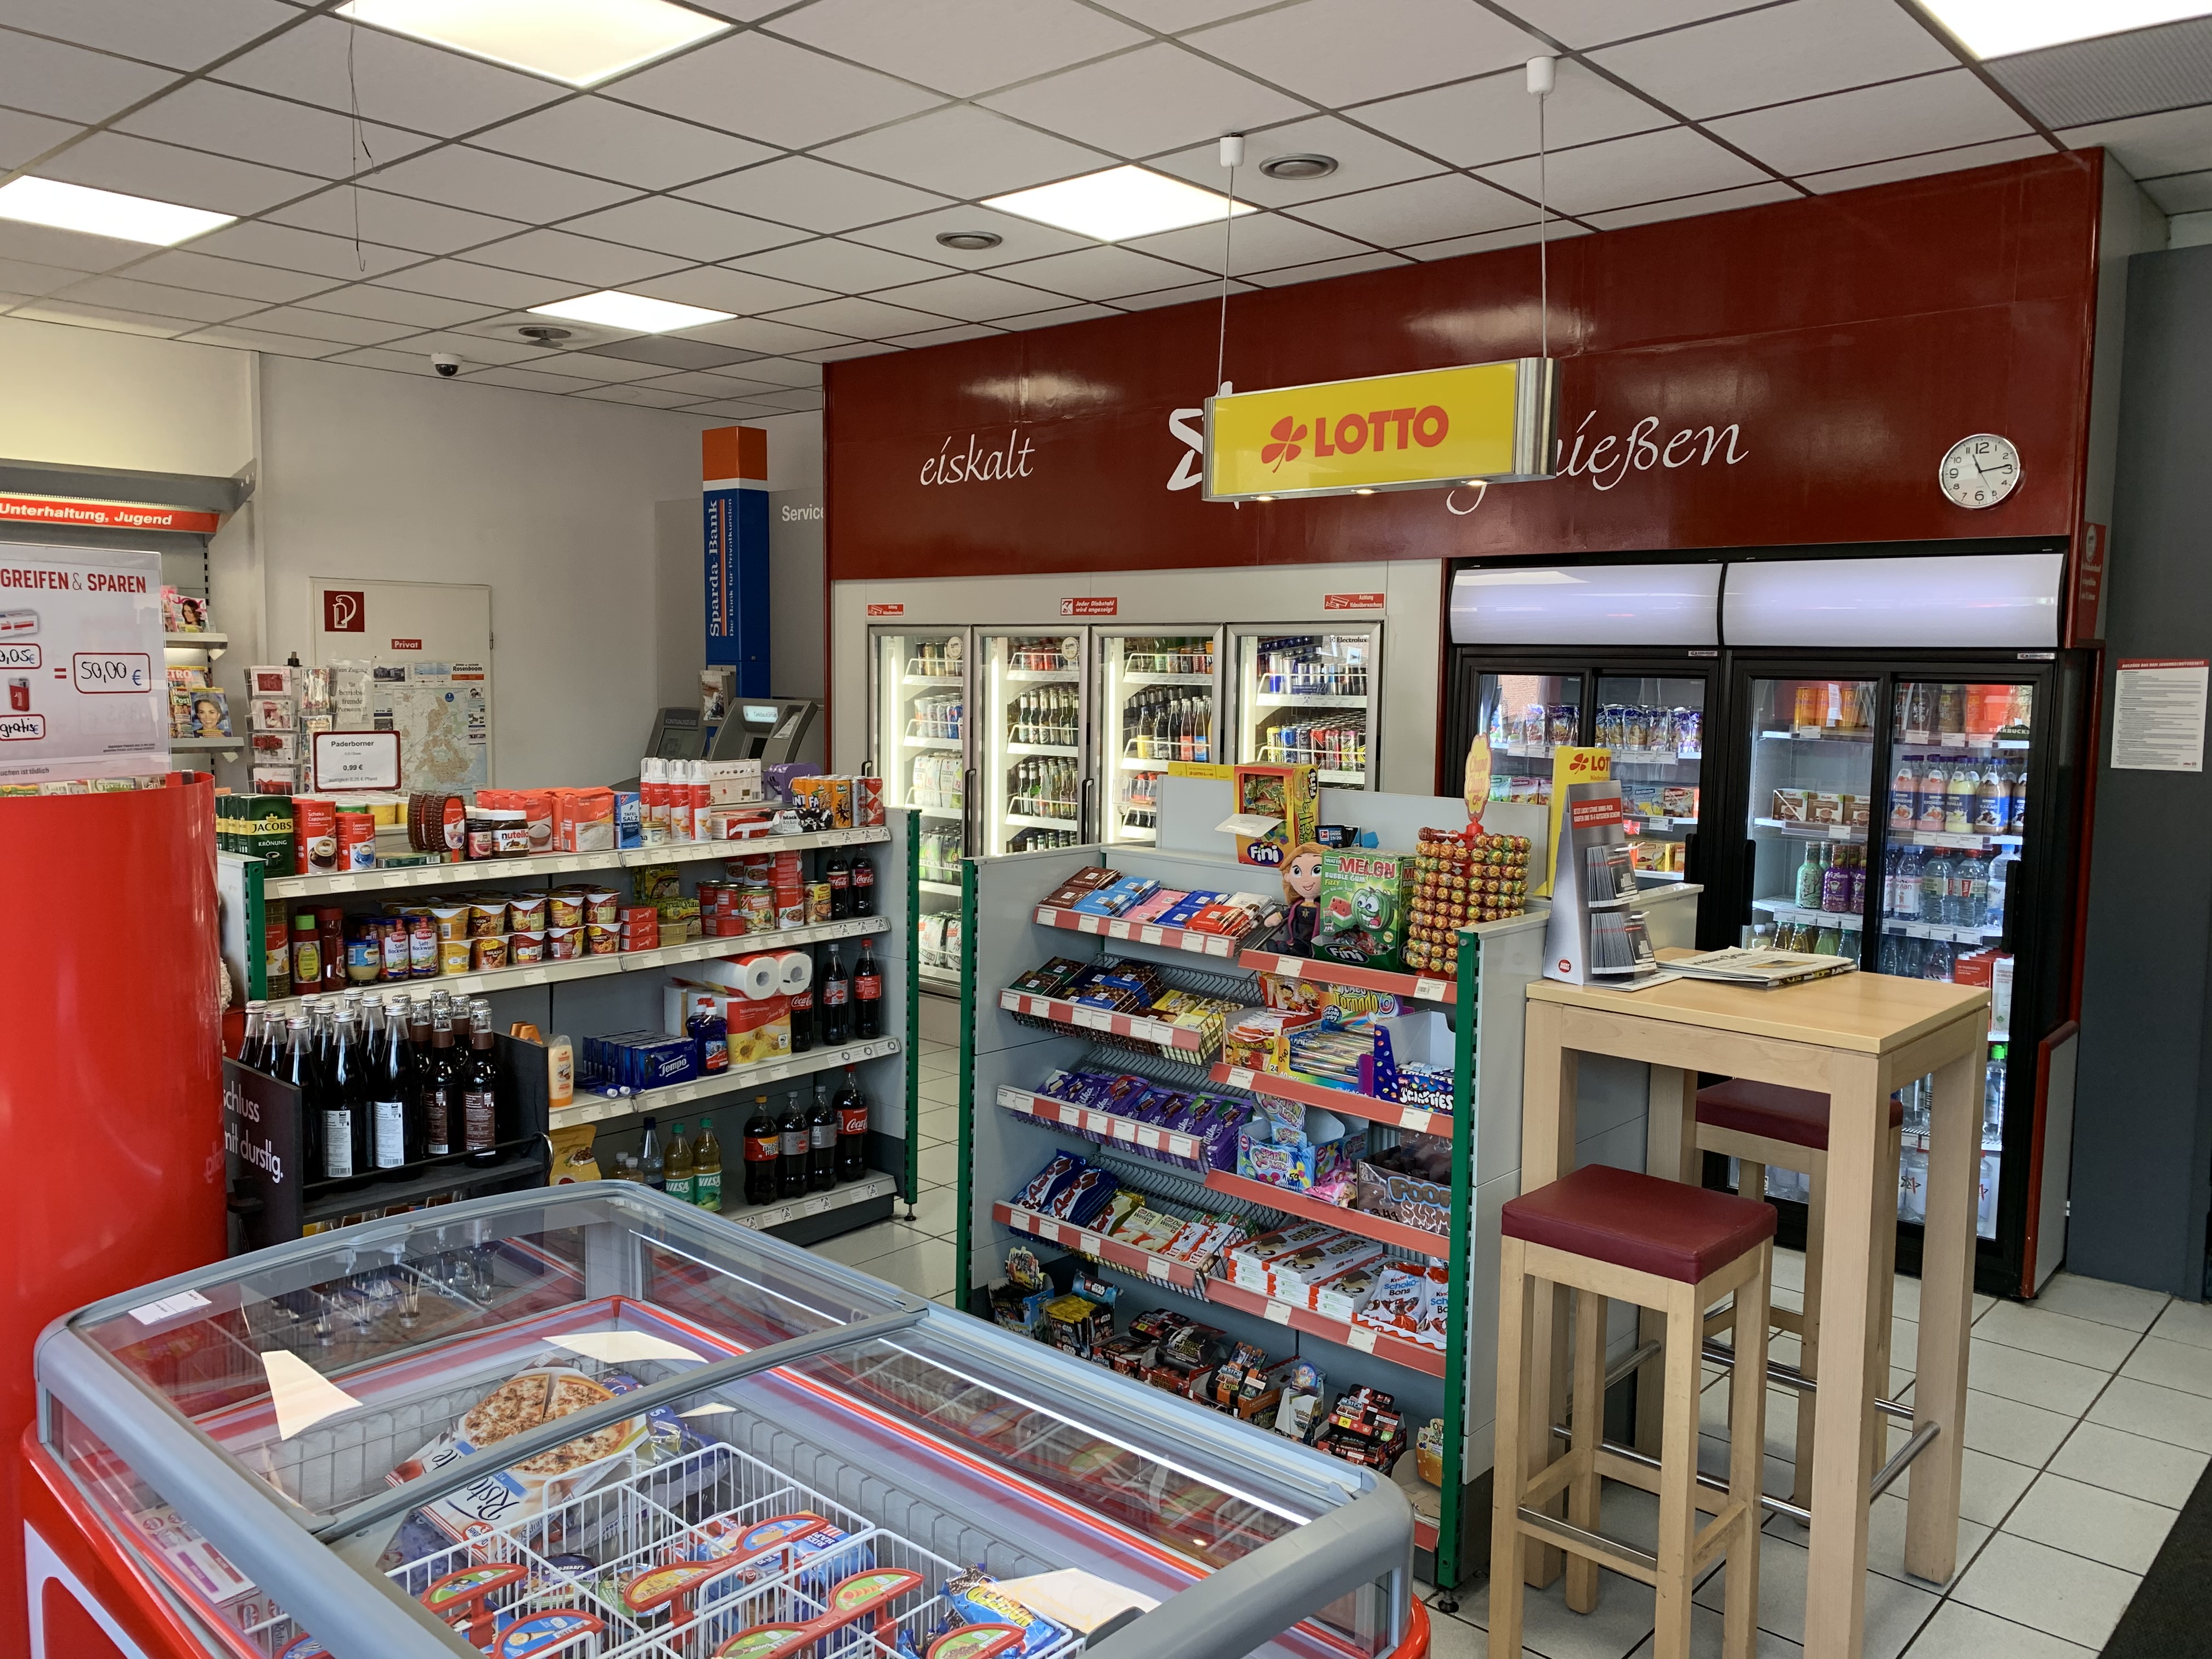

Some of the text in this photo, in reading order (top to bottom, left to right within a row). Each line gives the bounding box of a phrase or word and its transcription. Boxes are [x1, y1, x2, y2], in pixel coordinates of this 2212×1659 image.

[1314, 405, 1449, 458] LOTTO
[1976, 442, 1989, 454] 12
[920, 428, 1035, 486] eiskalt
[1949, 468, 1959, 478] 9
[2002, 464, 2013, 475] 3
[1975, 490, 1984, 501] 6
[1, 503, 172, 525] Unterhaltung, Jugend
[708, 500, 721, 637] Sparda-Bank
[1, 568, 146, 593] GREIFEN & SPAREN
[394, 640, 419, 648] Privat
[81, 661, 142, 686] 50,00 €
[172, 688, 188, 697] Neue
[173, 696, 190, 704] Post
[1988, 726, 2029, 735] STARBUCKS
[252, 822, 292, 834] JACOBS
[501, 830, 529, 839] nutella
[258, 839, 287, 847] KRÖNUNG
[1250, 844, 1280, 863] Fini
[1325, 857, 1342, 865] WATER
[1339, 856, 1396, 879] MELON
[1325, 872, 1365, 883] BUBBLE GUM
[416, 930, 432, 938] Meica
[1329, 946, 1364, 962] Fini
[1334, 990, 1379, 1013] Tornado
[659, 1058, 687, 1077] Tempo
[1400, 1086, 1454, 1111] SMARTIES
[240, 1129, 284, 1184] durstig.
[1028, 1164, 1055, 1201] Aero
[1054, 1180, 1082, 1217] Aero
[1133, 1214, 1154, 1226] Weisse
[1146, 1210, 1156, 1219] Die
[1160, 1222, 1181, 1234] Weisse
[1172, 1220, 1183, 1229] Die
[1384, 1279, 1421, 1290] Schoko-
[1091, 1287, 1105, 1296] WARS
[1389, 1288, 1411, 1296] Bons
[1173, 1342, 1199, 1357] WARS
[1178, 1338, 1199, 1351] STAR
[1219, 1365, 1242, 1377] MATCH
[1221, 1383, 1240, 1391] ACTION
[1340, 1398, 1362, 1409] MATCH
